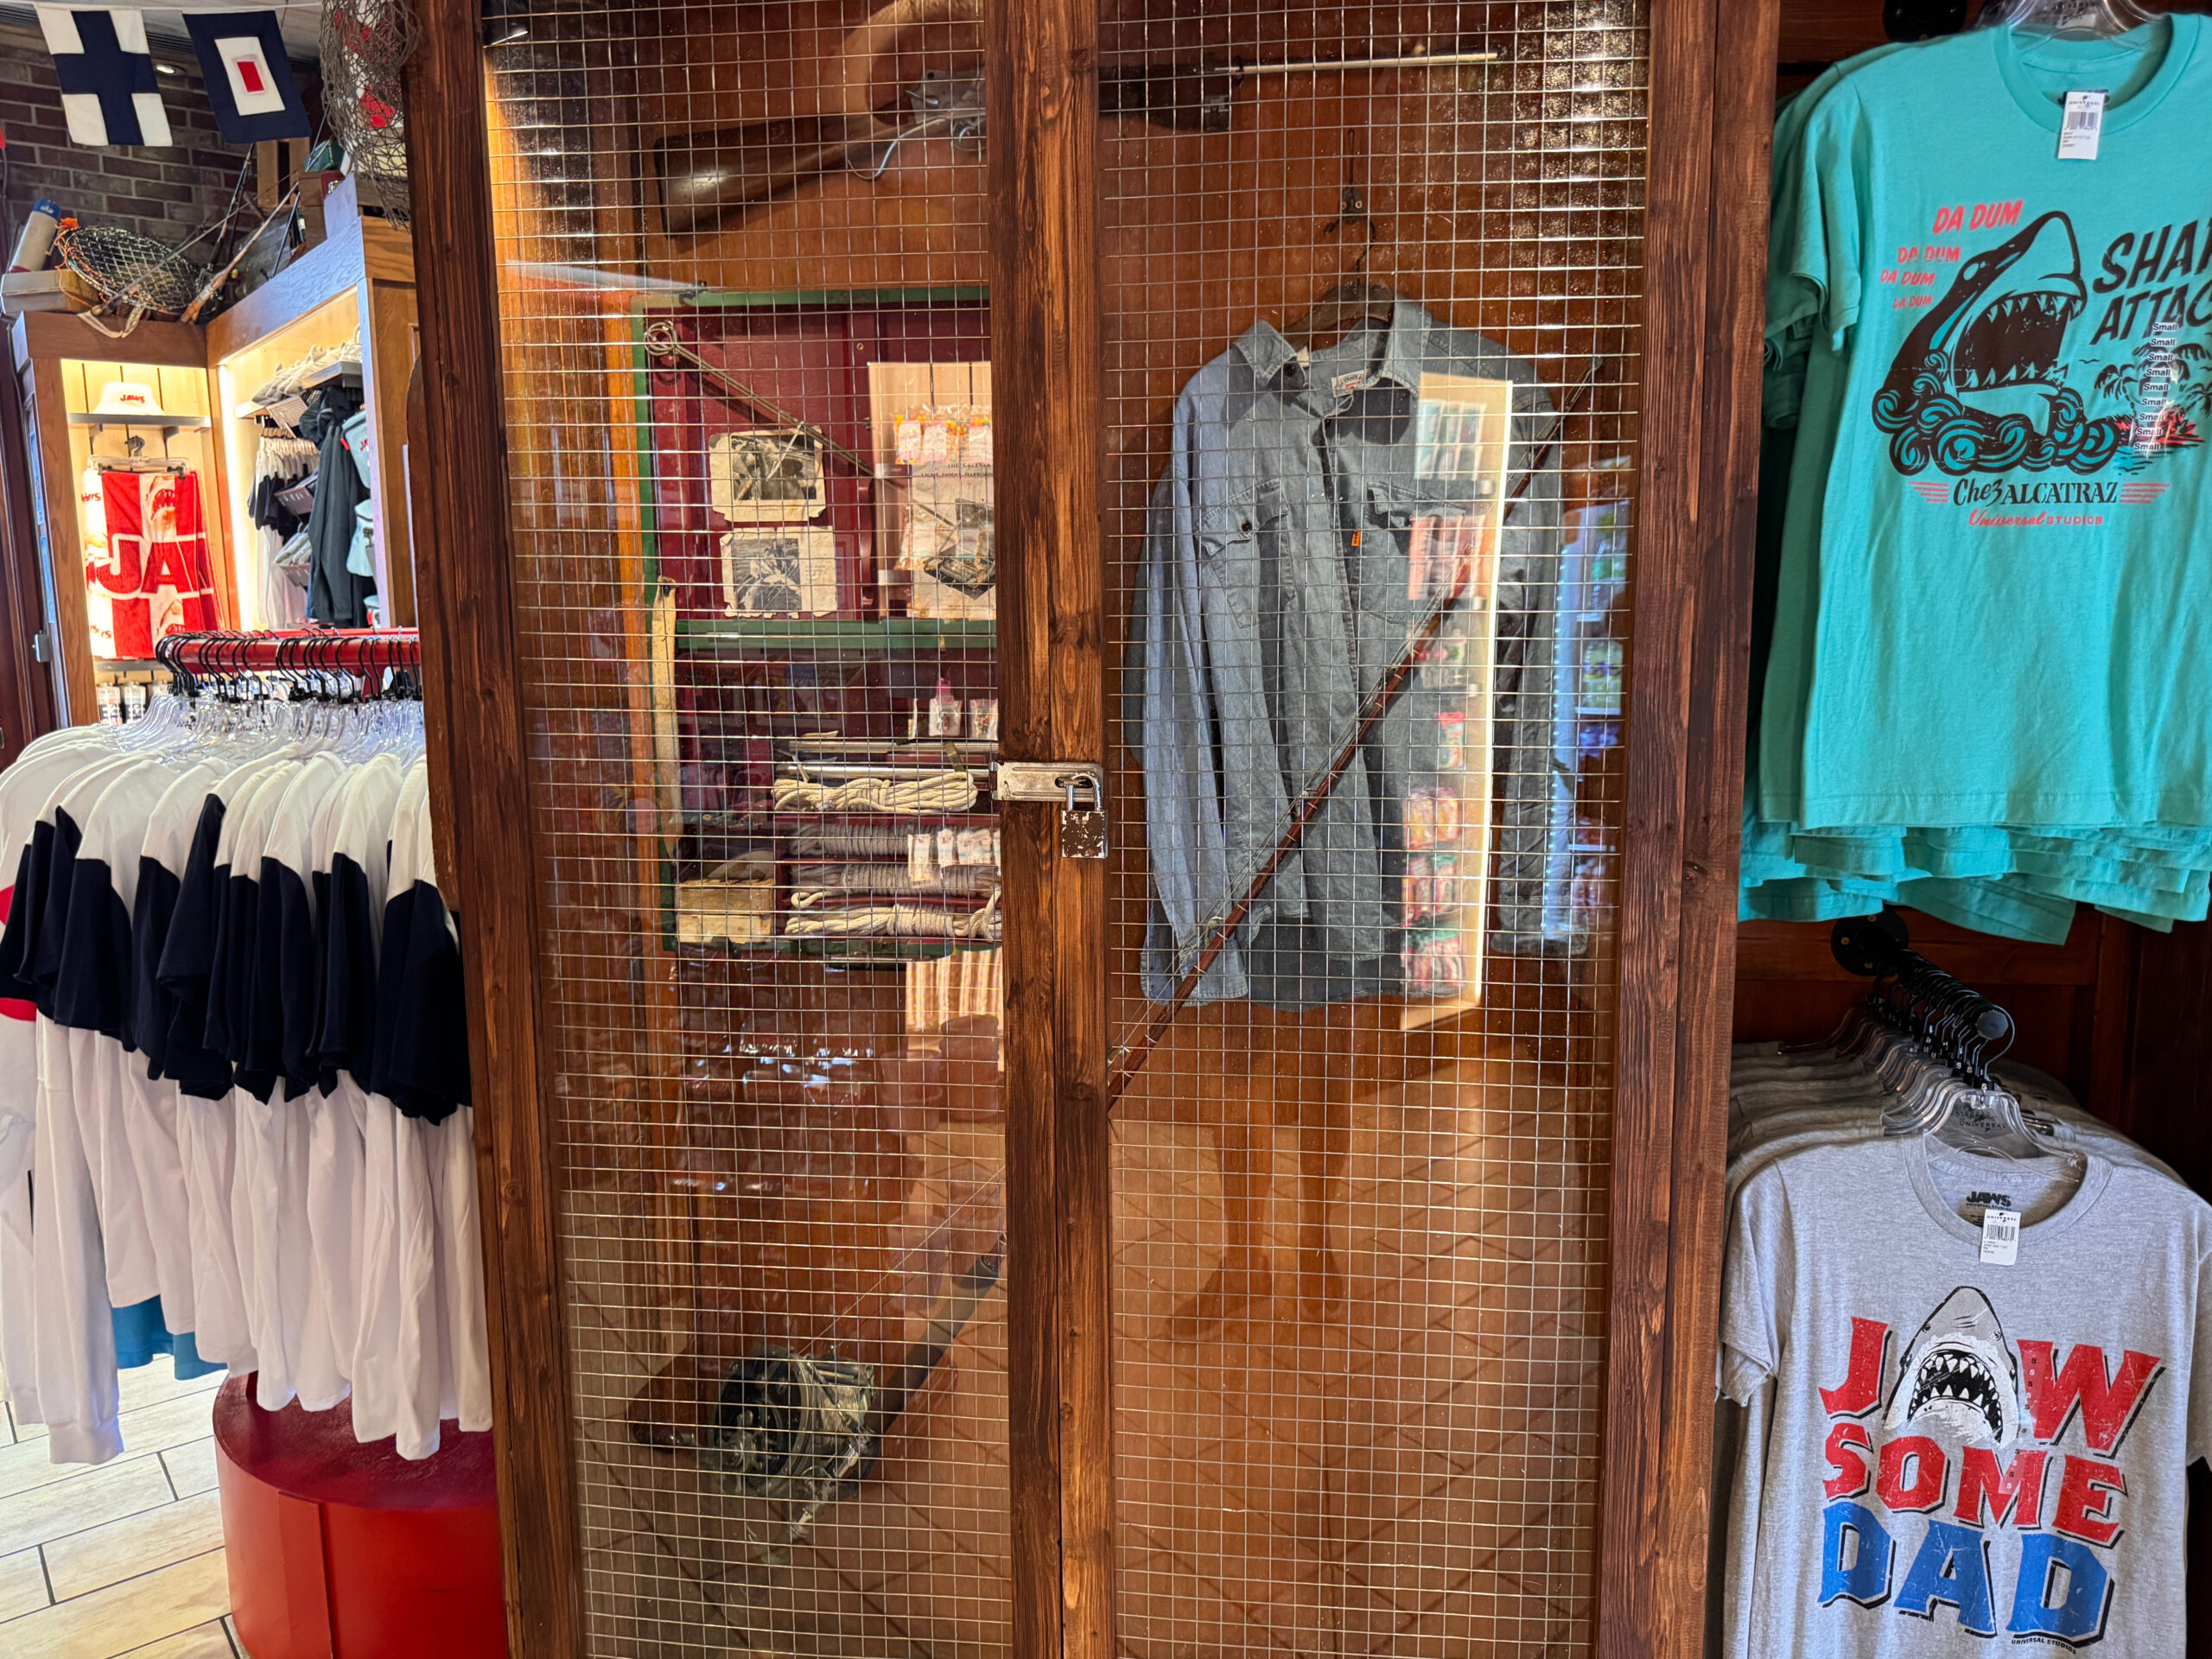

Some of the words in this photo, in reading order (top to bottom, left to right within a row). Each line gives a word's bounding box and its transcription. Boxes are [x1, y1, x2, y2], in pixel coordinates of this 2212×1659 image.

[1933, 206, 1964, 235] DA
[1969, 200, 2024, 231] DUM
[1897, 247, 1918, 264] DA
[1924, 246, 1960, 263] DUM
[1880, 270, 1897, 284] DA
[1900, 271, 1936, 286] DUM
[1909, 295, 1933, 308] DUM
[2000, 481, 2117, 505] ALCATRAZ
[1968, 509, 2047, 526] Universal
[2047, 516, 2103, 525] STUDIOS
[1967, 1191, 2012, 1207] JAWS
[1821, 1422, 2128, 1549] SOME
[1817, 1502, 2115, 1649] DAD
[2047, 1639, 2077, 1655] STUDIOS
